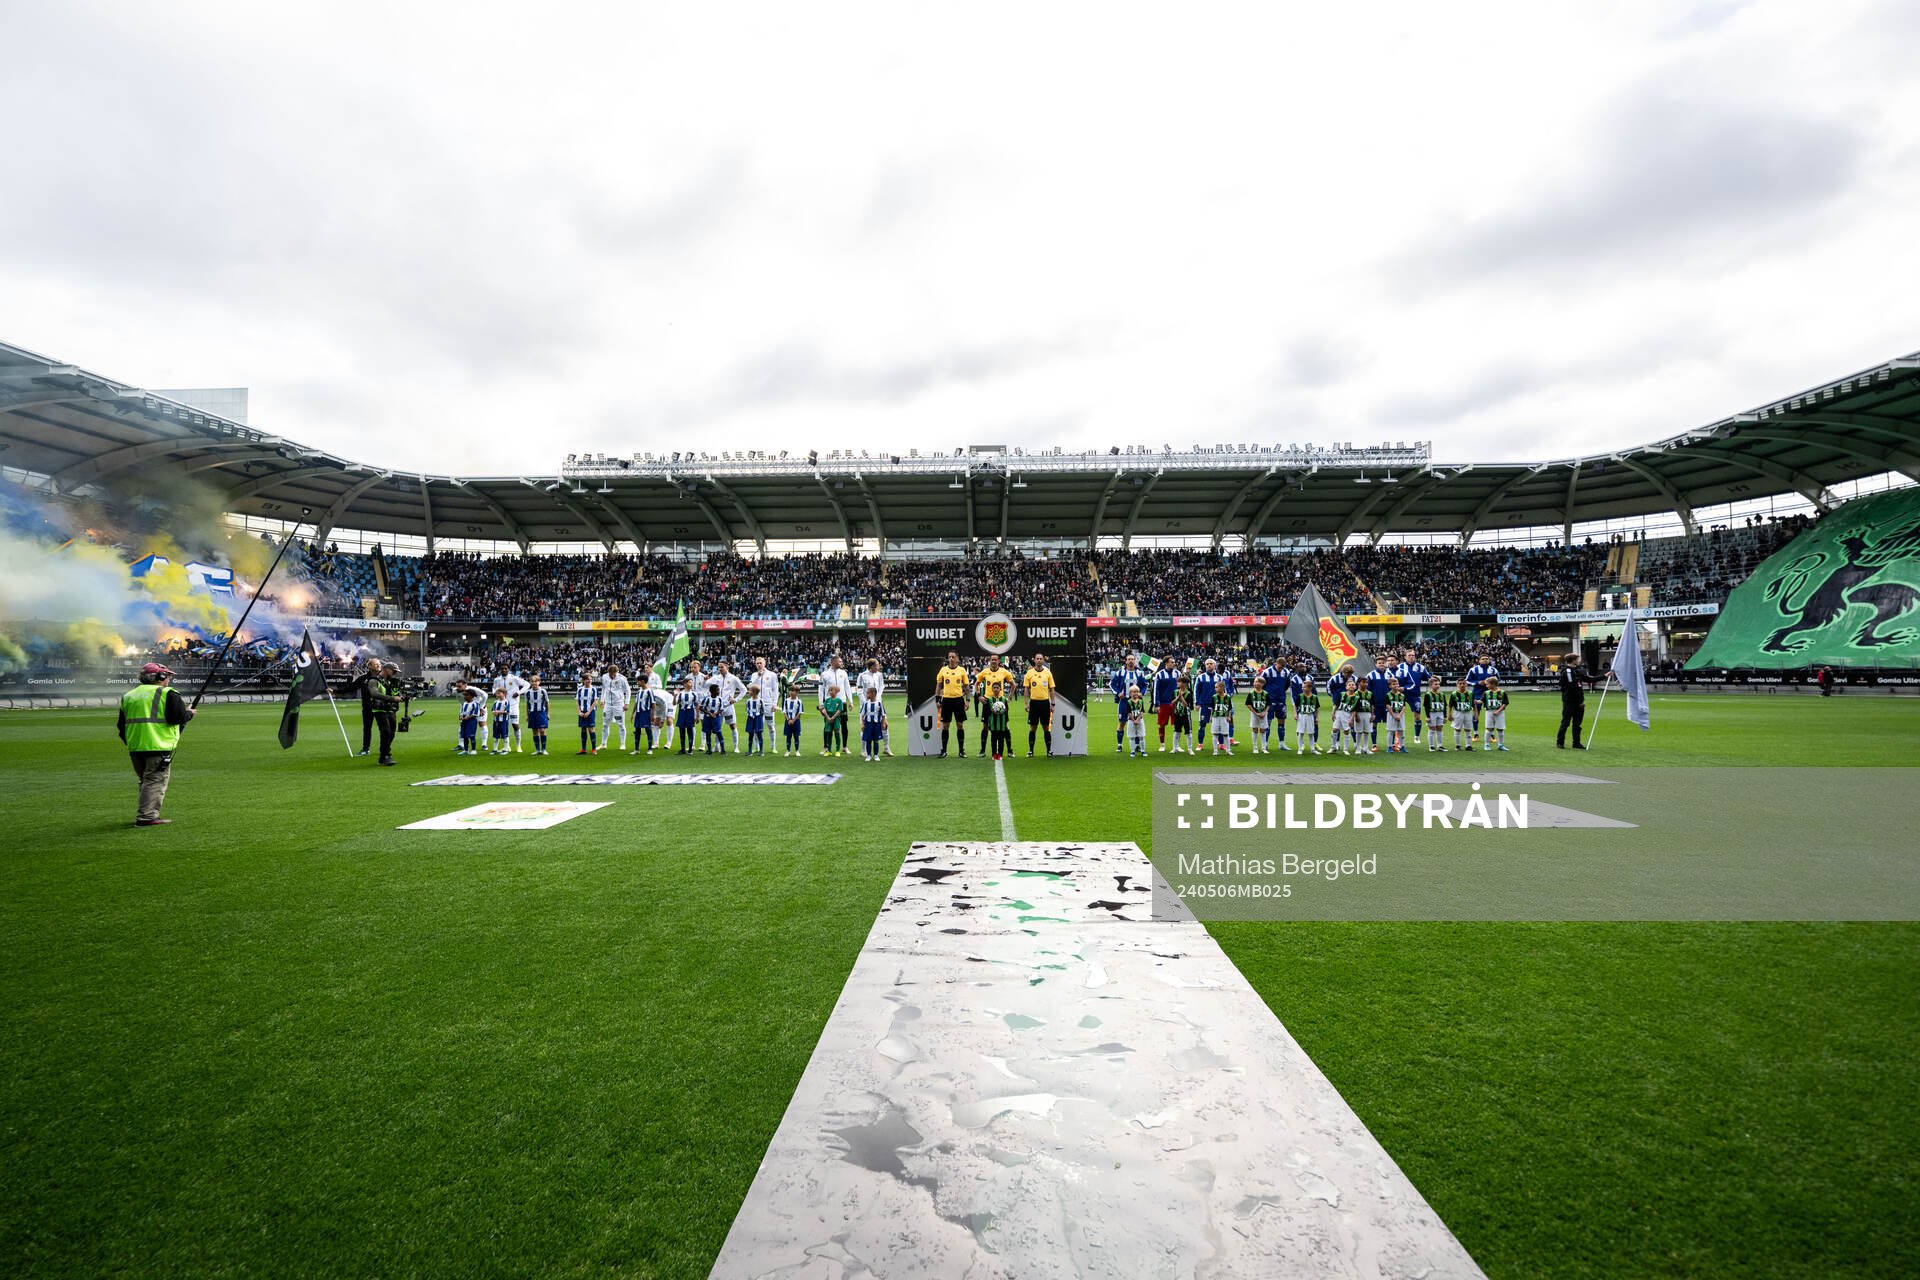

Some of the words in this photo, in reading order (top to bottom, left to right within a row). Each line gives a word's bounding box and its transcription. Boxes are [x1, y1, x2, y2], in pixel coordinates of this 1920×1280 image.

[1654, 605, 1715, 617] merinfo.se
[1421, 615, 1442, 623] FAT21
[1507, 613, 1561, 622] merinfo.se
[369, 621, 424, 630] merinfo.se
[556, 622, 575, 630] FAT21
[916, 628, 966, 639] UNIBET
[1027, 627, 1077, 638] UNIBET
[920, 716, 933, 731] U
[1062, 715, 1075, 731] U
